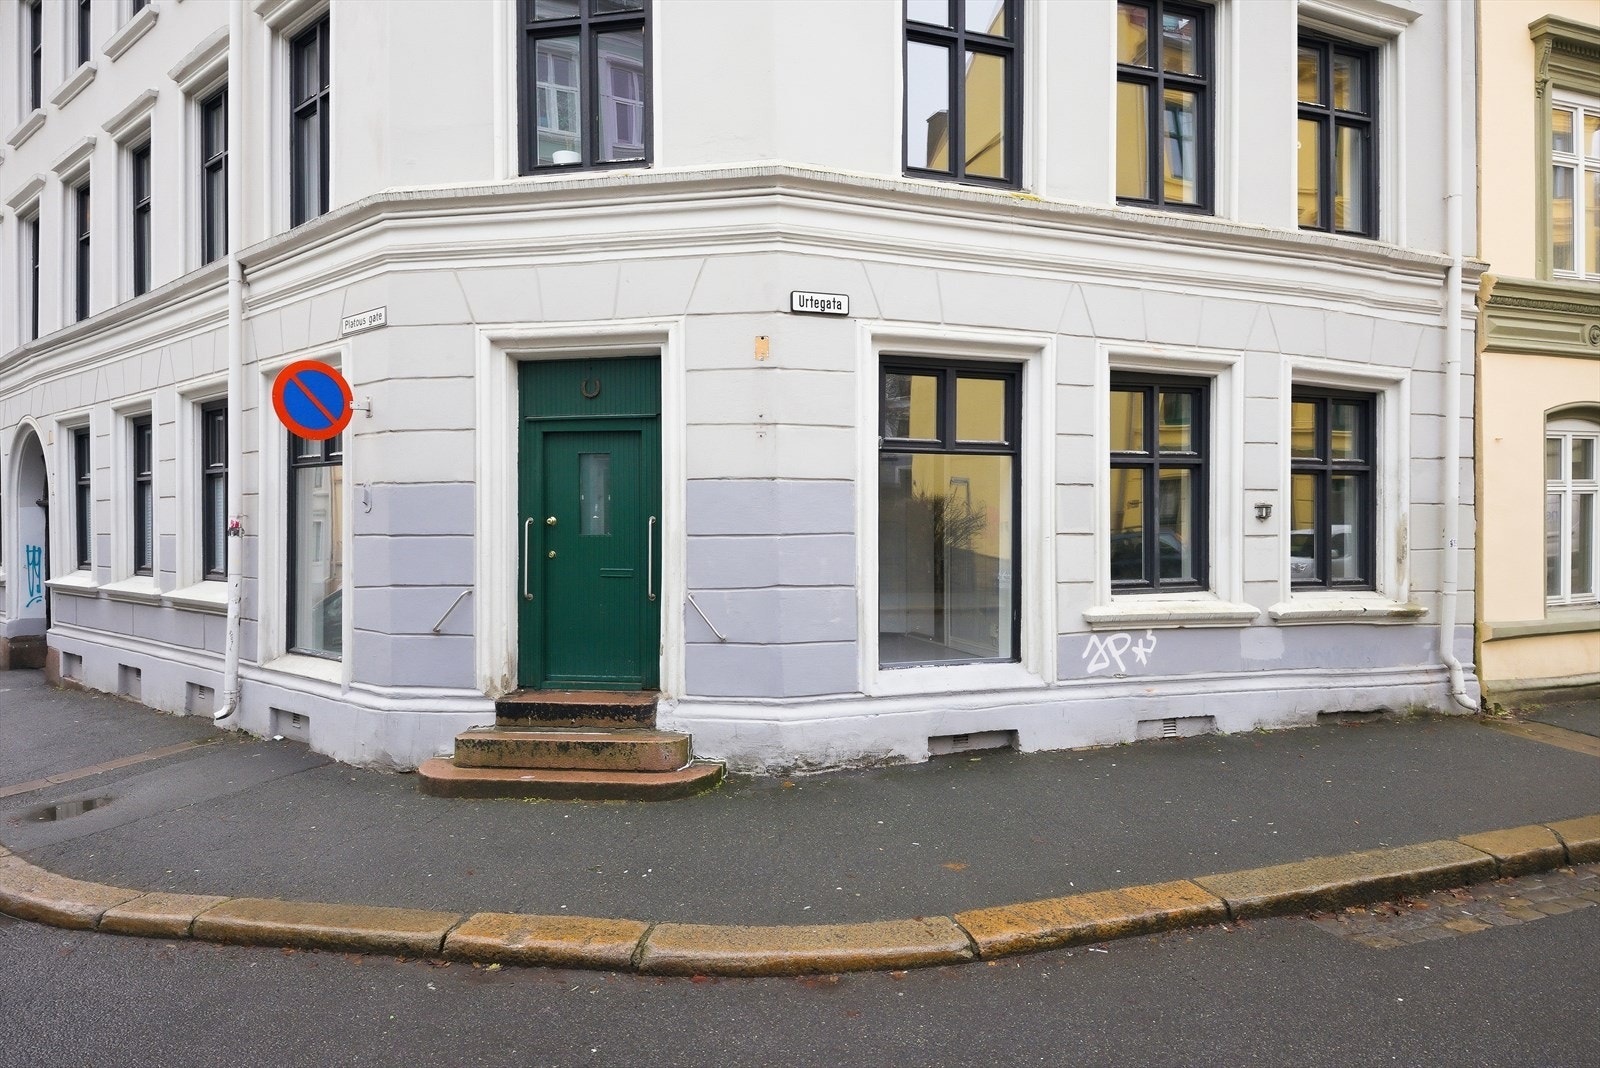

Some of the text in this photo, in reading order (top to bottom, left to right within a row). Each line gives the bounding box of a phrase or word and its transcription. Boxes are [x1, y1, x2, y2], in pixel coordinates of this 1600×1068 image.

[798, 294, 842, 312] Urtegata
[344, 312, 383, 330] Platous gate
